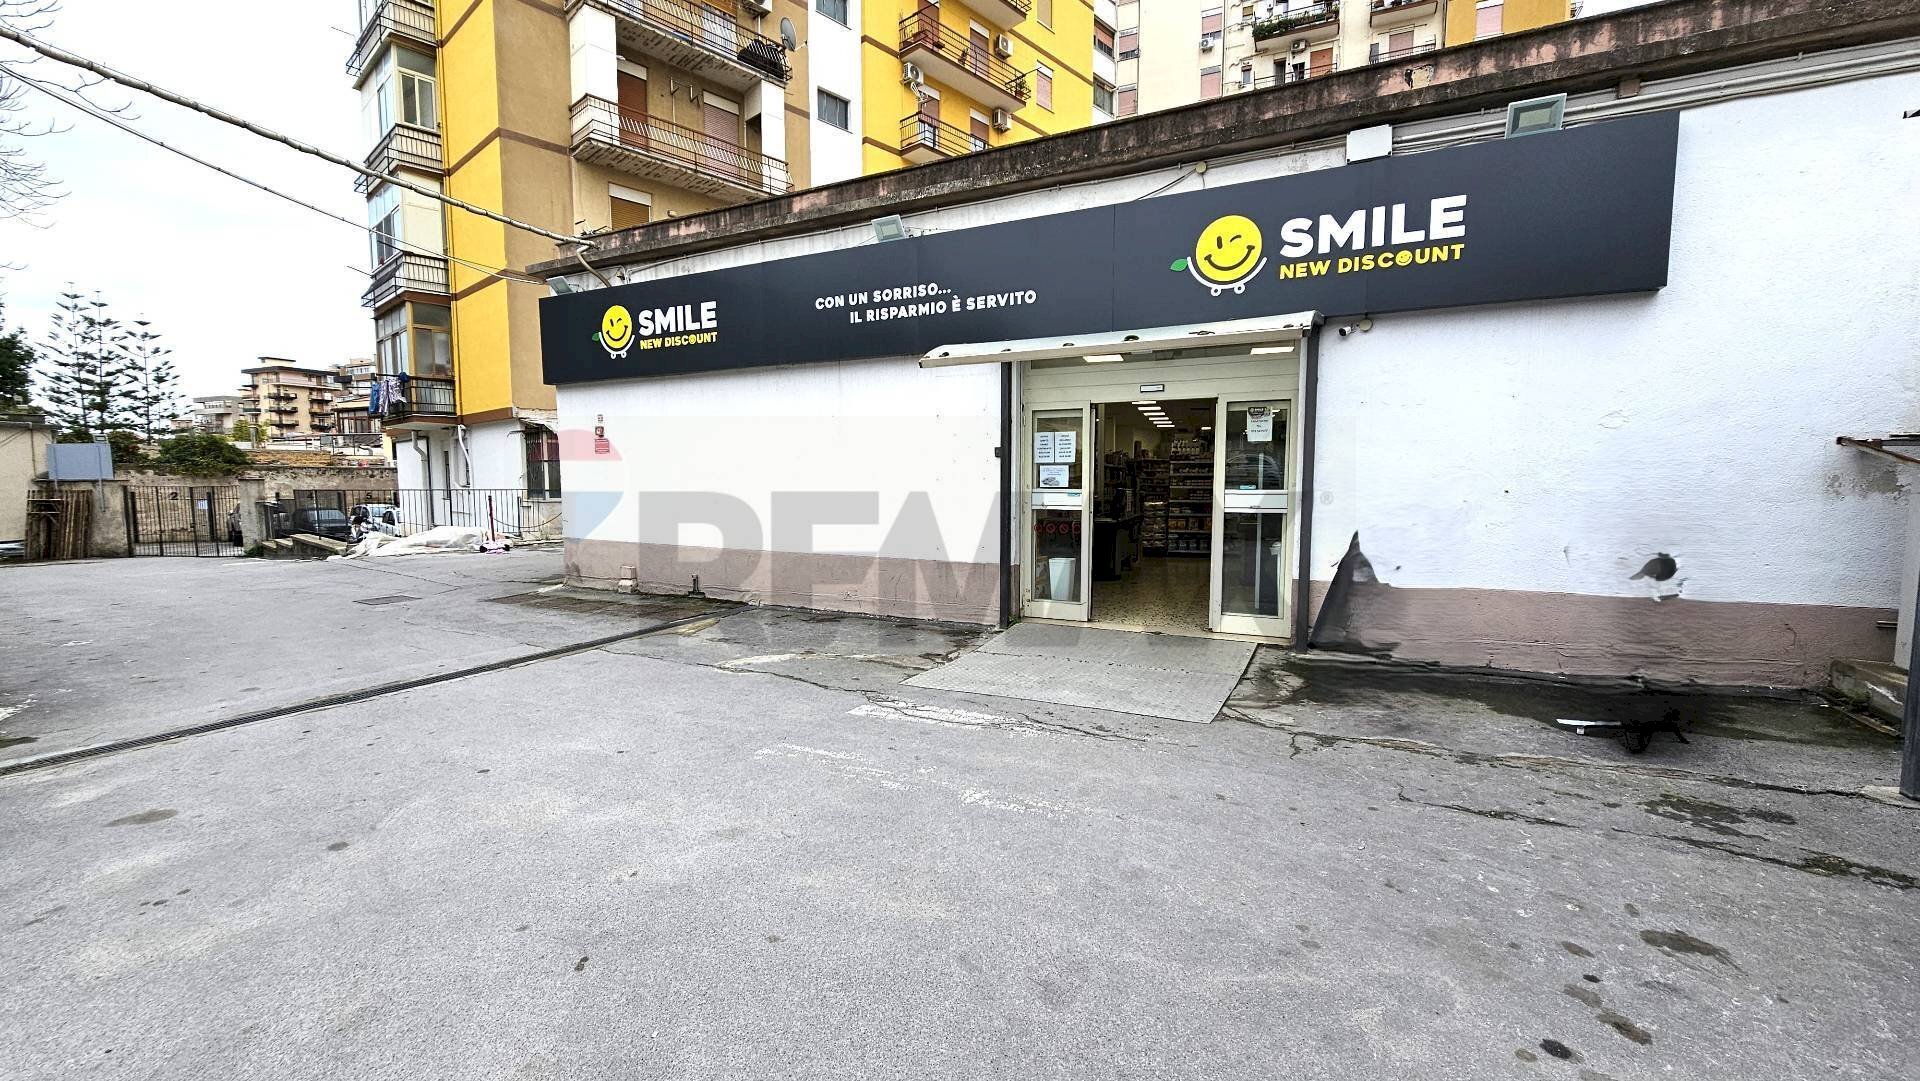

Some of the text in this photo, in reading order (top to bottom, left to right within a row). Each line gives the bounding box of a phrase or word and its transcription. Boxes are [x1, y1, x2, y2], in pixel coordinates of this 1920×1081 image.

[1279, 195, 1467, 258] SMILE
[1279, 244, 1465, 280] NEW DISCOUNT
[815, 283, 952, 309] CON UN SORRISO...
[850, 290, 1037, 324] IL RISPARMIO È SERVITO
[638, 300, 718, 337] SMILE
[640, 331, 718, 350] NEW DISCOUNT
